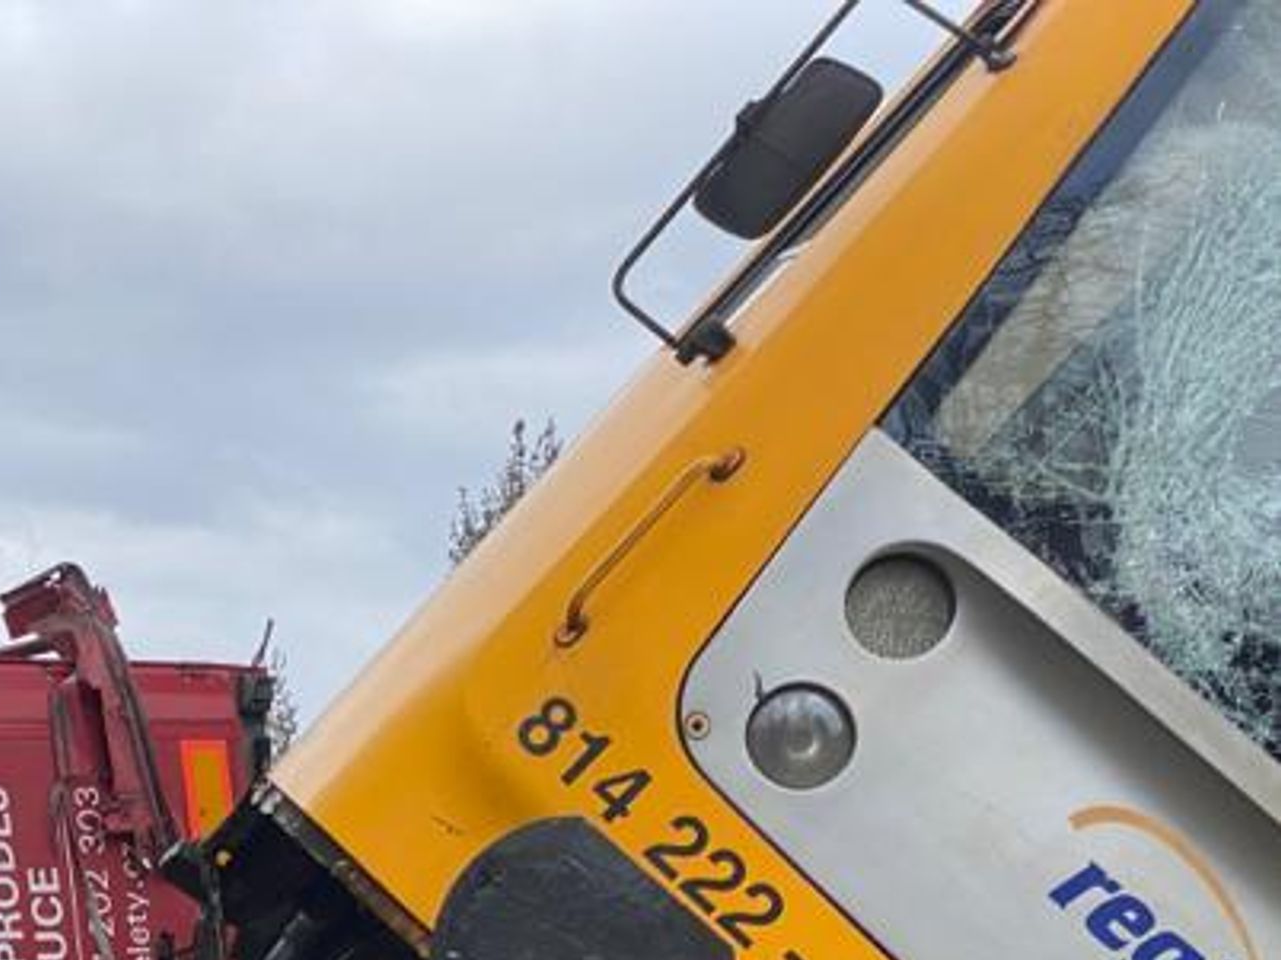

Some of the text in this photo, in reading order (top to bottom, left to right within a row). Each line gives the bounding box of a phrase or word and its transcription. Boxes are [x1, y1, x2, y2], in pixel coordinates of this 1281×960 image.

[73, 786, 104, 855] 303
[518, 698, 652, 822] 814
[644, 815, 785, 949] 222
